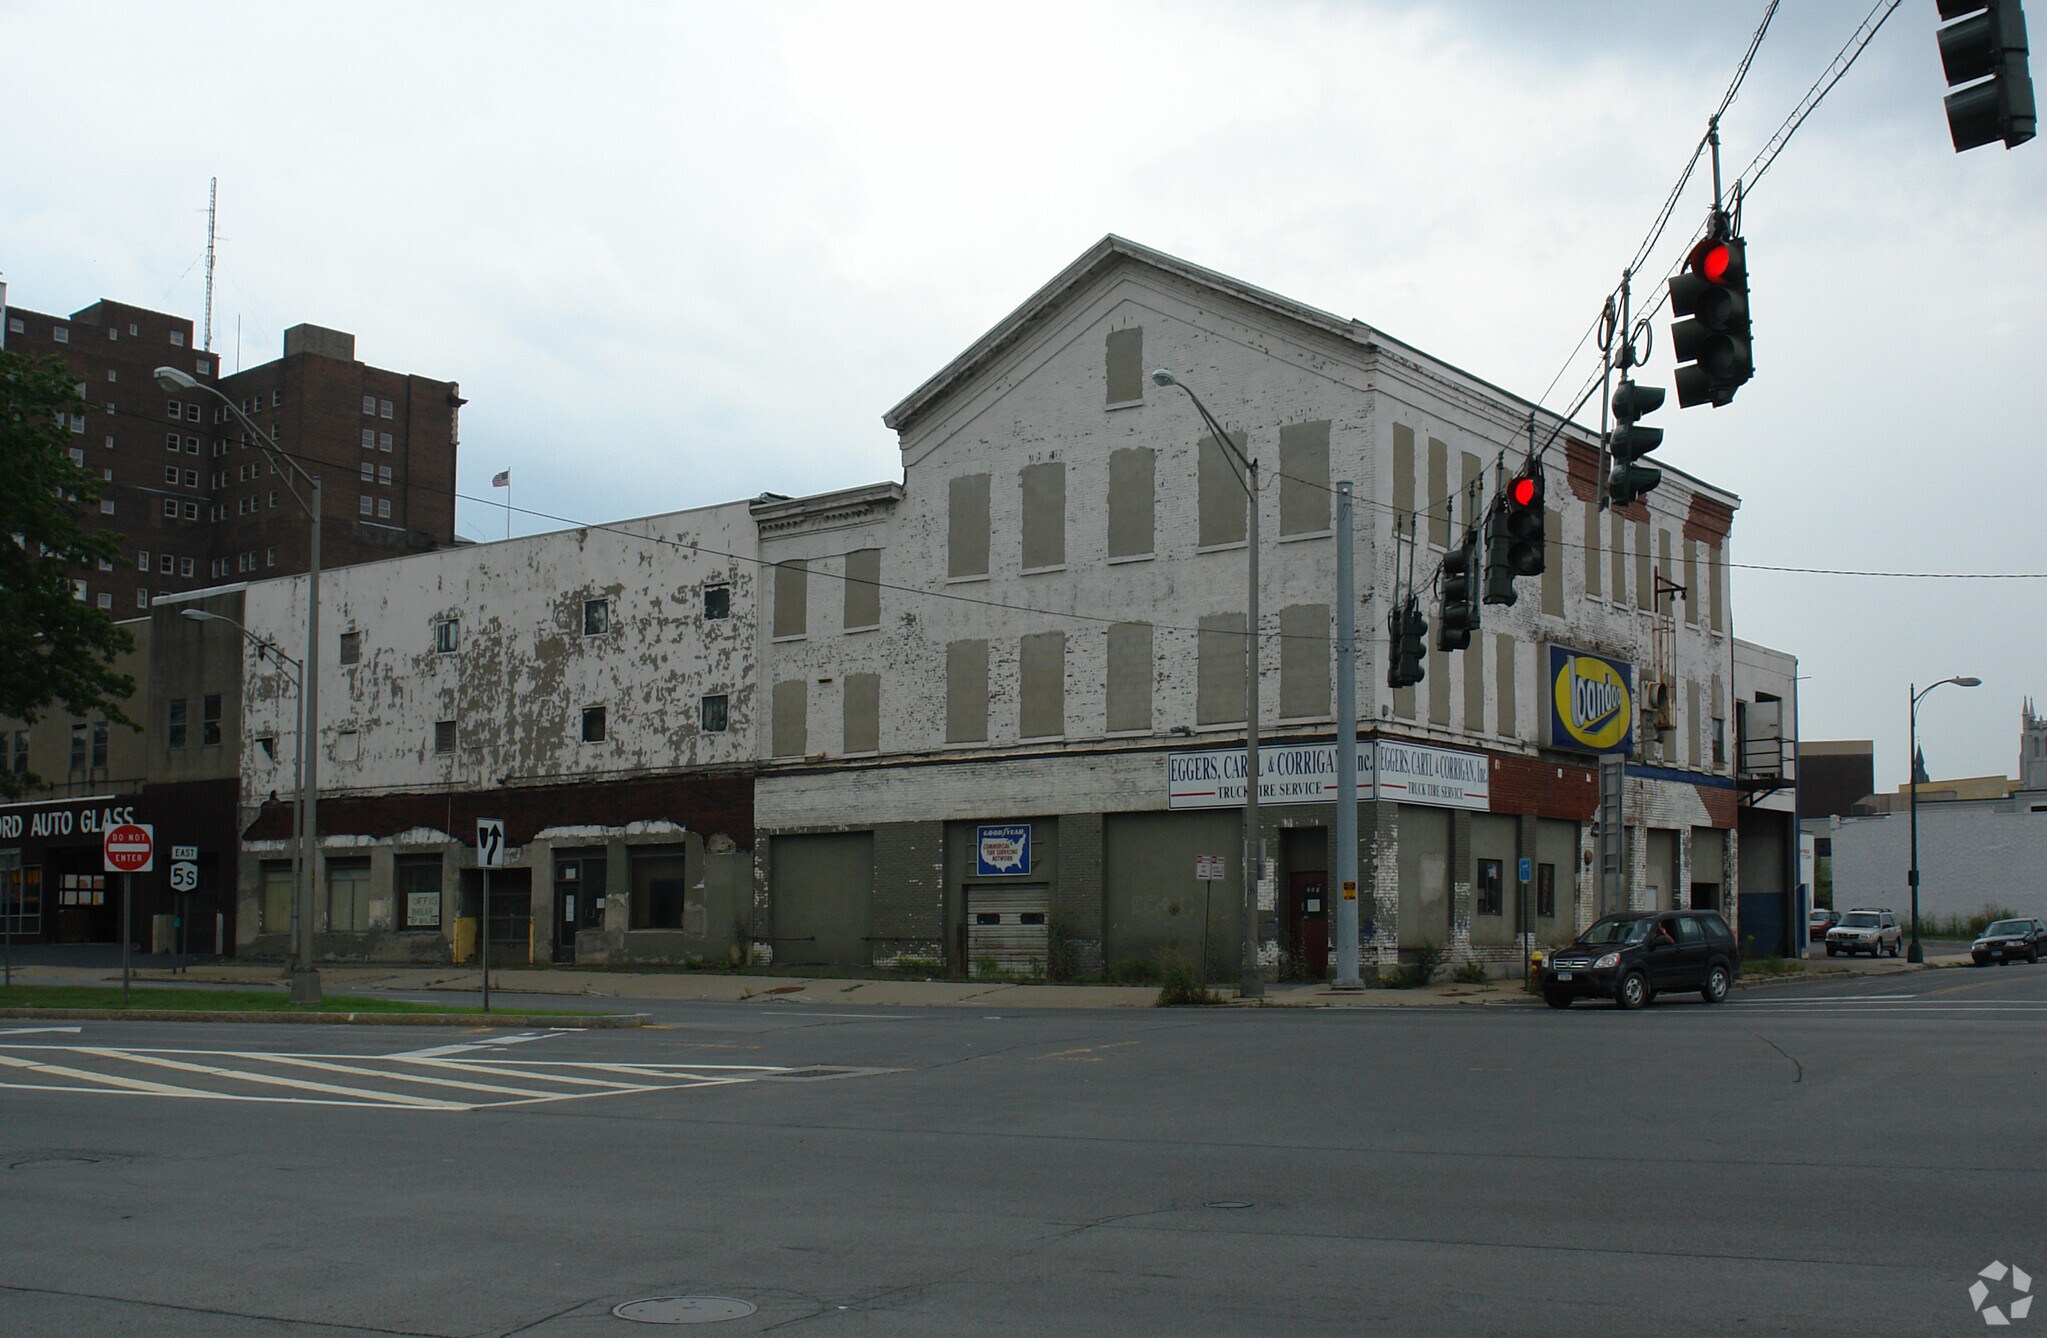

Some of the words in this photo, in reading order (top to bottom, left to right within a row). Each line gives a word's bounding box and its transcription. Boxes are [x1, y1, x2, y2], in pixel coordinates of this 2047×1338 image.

[1170, 753, 1221, 783] EGGERS,
[1223, 752, 1264, 780] CARL
[1268, 755, 1274, 773] &
[1277, 749, 1338, 776] CORRIGA
[1357, 754, 1373, 772] nc.
[1380, 746, 1410, 775] EGGERS,
[1411, 751, 1433, 776] CARYL
[1435, 757, 1439, 774] &
[1440, 756, 1476, 784] CORRIGAN,
[1477, 760, 1487, 783] Inc.
[1217, 786, 1248, 799] TRUCK
[1257, 784, 1276, 797] IRE
[1279, 782, 1322, 796] SERVICE
[1407, 781, 1425, 796] TRUCK
[1426, 783, 1440, 798] TIRE
[1441, 785, 1464, 800] SERVICE
[0, 815, 23, 839] RD
[30, 810, 73, 837] AUTO
[80, 806, 135, 834] GLASS
[112, 833, 124, 841] DO
[128, 833, 146, 841] NOT
[983, 828, 1024, 837] GOODYEAR
[115, 854, 143, 862] ENTER
[175, 848, 194, 857] EAST
[173, 868, 195, 886] 5S
